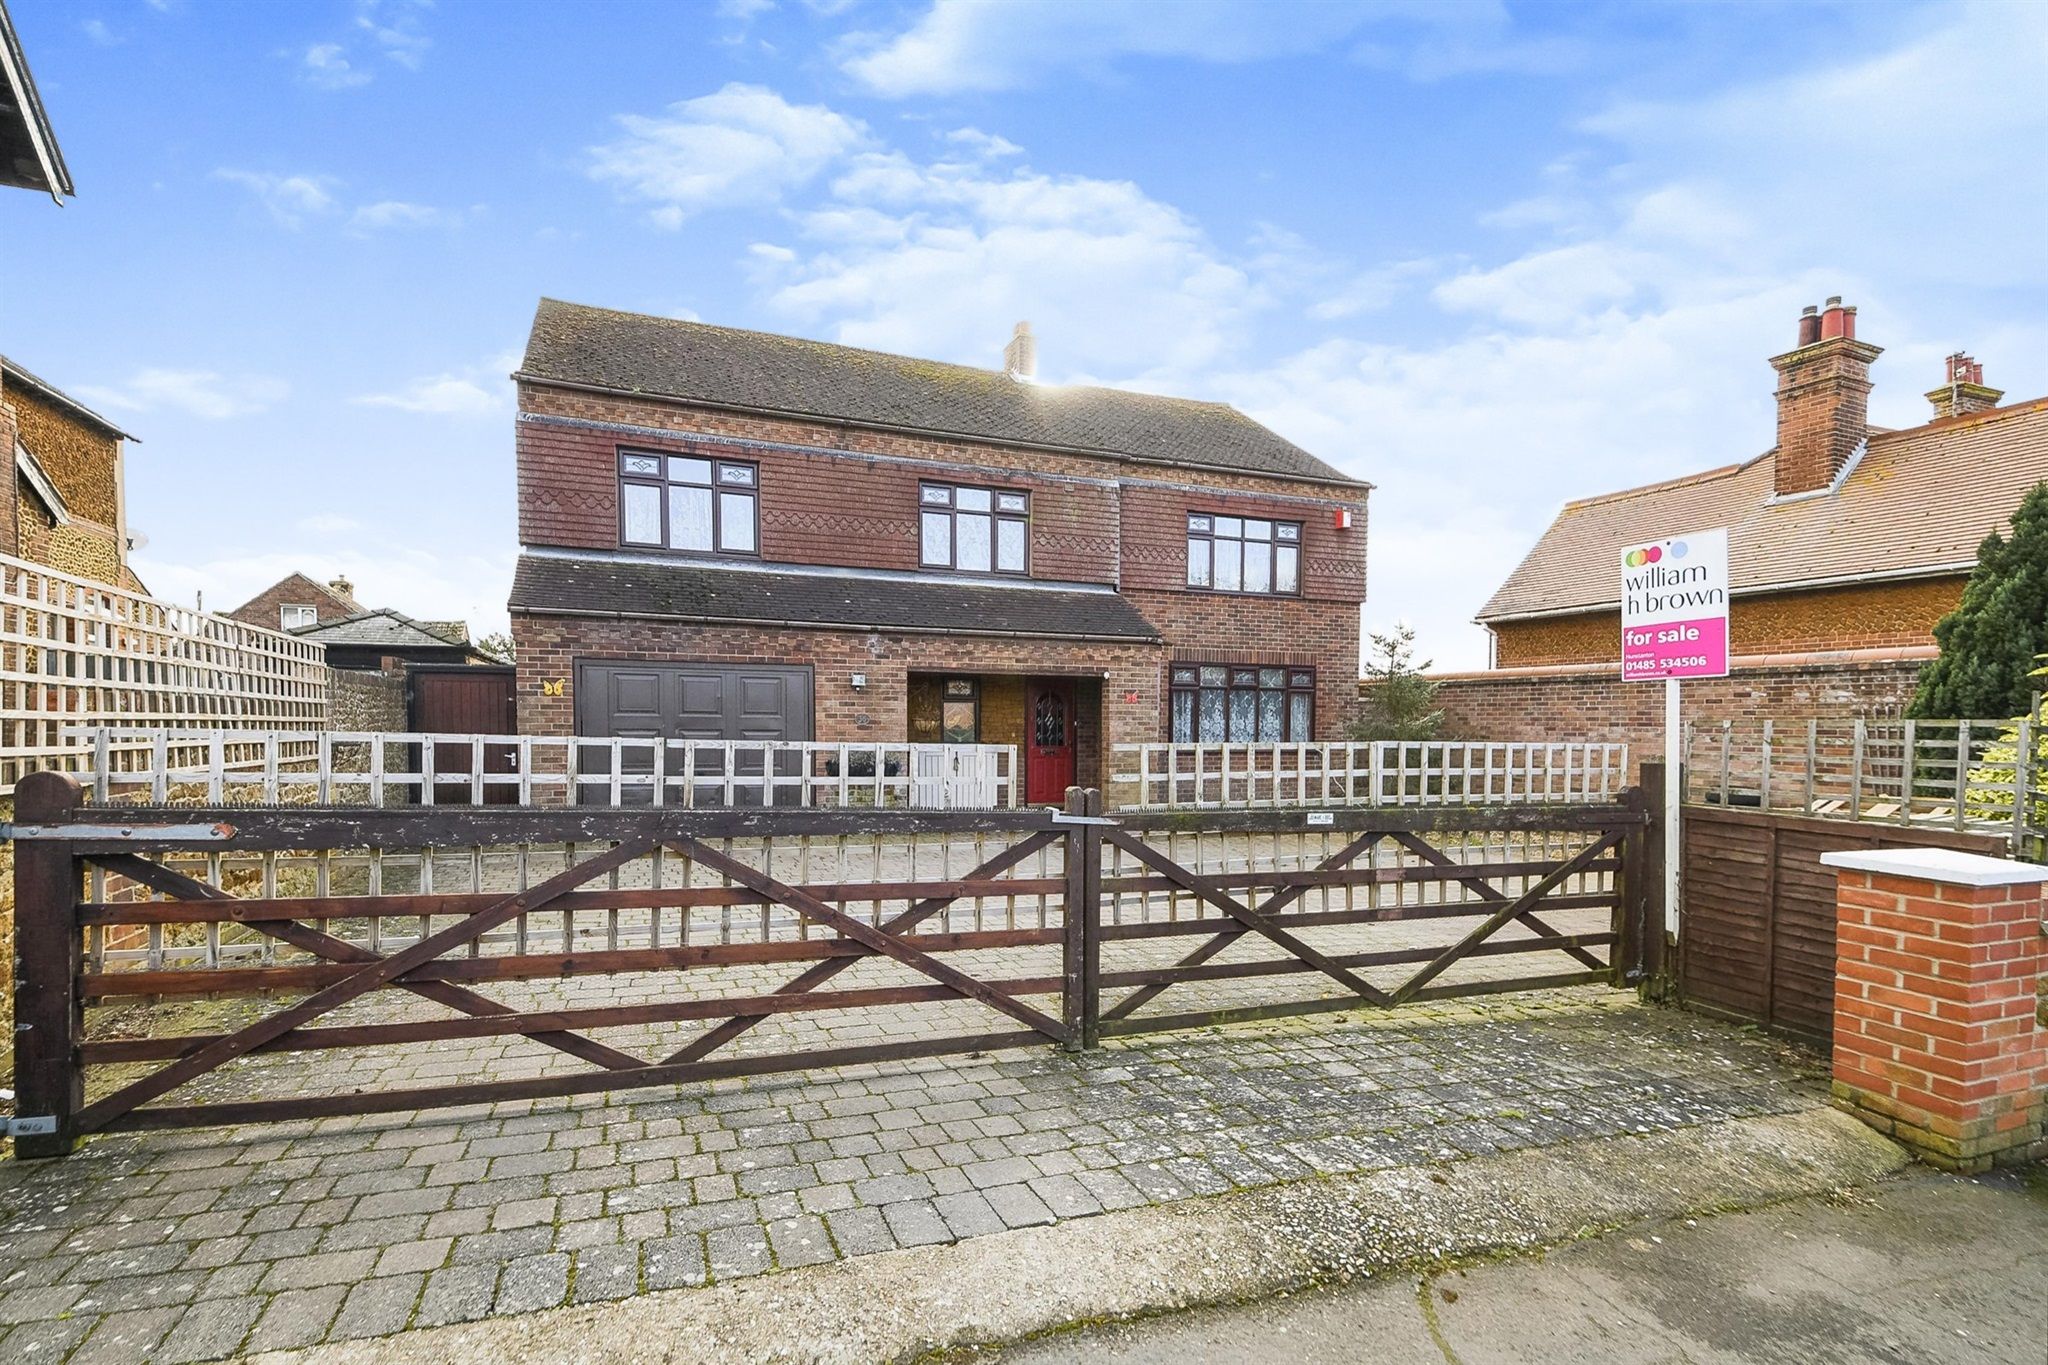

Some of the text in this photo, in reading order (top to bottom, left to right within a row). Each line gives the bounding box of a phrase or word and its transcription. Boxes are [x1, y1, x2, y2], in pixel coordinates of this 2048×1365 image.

[1626, 565, 1707, 592] william
[1628, 588, 1723, 615] h brown
[1625, 624, 1700, 646] for sale
[1625, 656, 1707, 671] 01485 534506
